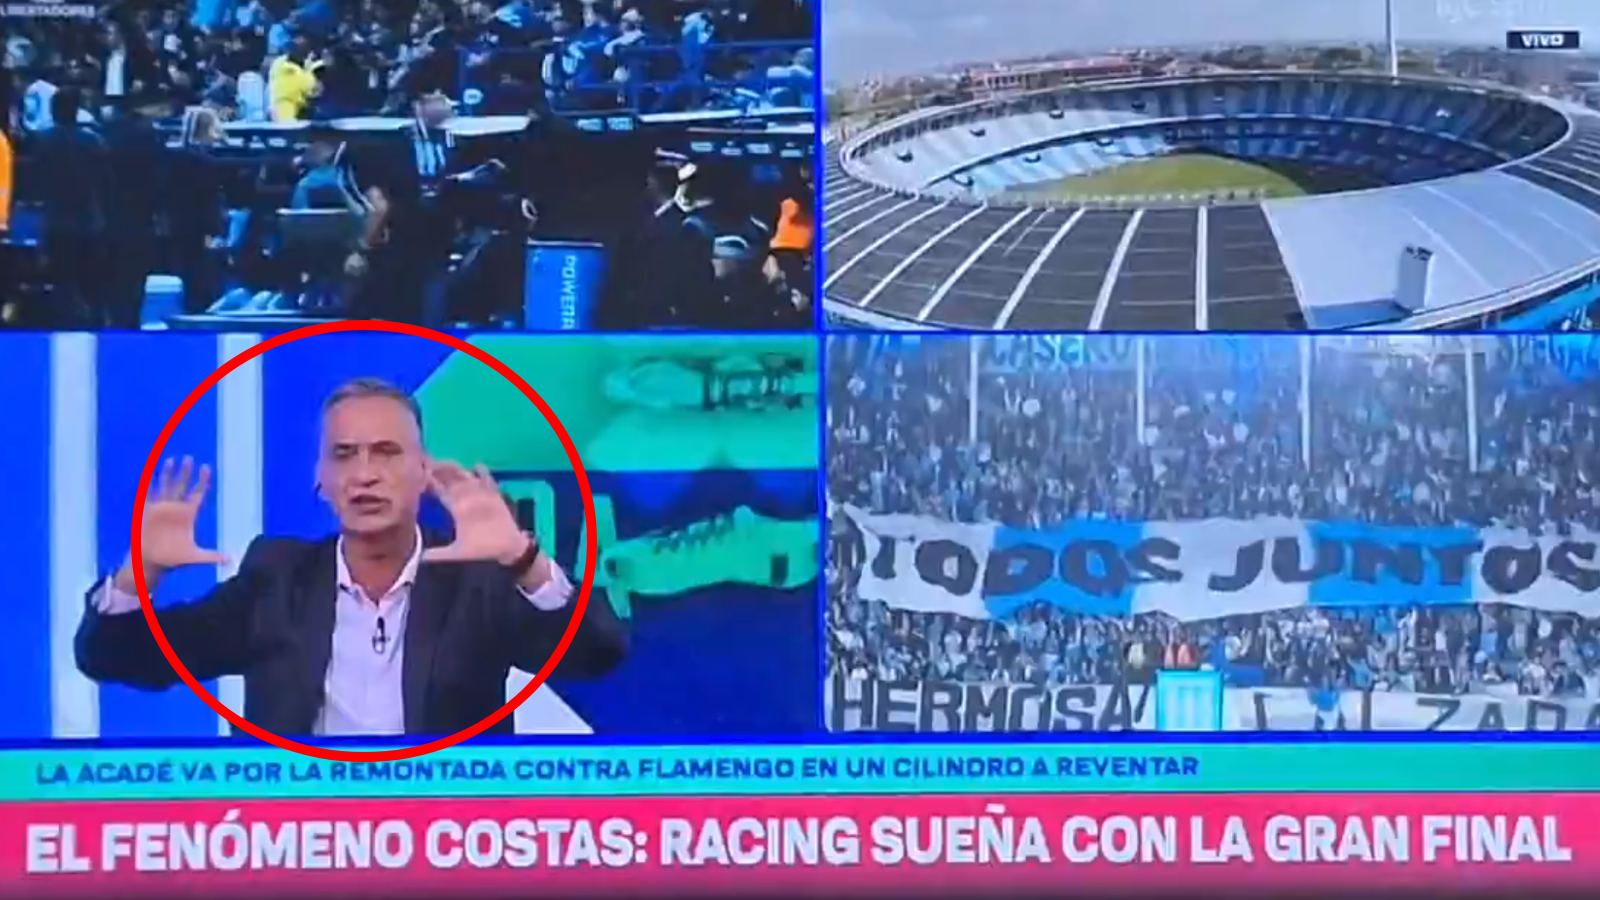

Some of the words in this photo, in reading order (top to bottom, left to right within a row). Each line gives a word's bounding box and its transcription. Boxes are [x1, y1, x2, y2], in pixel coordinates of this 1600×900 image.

[1521, 34, 1565, 47] VIVO
[872, 526, 1183, 597] TODOS
[1207, 535, 1600, 594] JUNTOS
[36, 764, 68, 784] LA
[183, 764, 216, 782] VA
[225, 763, 282, 782] POR
[290, 762, 322, 781] LA
[331, 760, 504, 782] REMONTADA
[515, 759, 630, 780] CONTRA
[639, 759, 794, 779] FLAMENGO
[802, 758, 838, 778] EN
[846, 759, 885, 777] UN
[893, 758, 1025, 777] CILINDRO
[1032, 758, 1048, 776] A
[1057, 757, 1199, 777] REVENTAR
[26, 824, 92, 873] EL
[102, 808, 414, 872] FENÓMENO
[425, 818, 648, 868] COSTAS:
[660, 816, 860, 866] RACING
[870, 802, 1052, 865] SUEÑA
[1061, 815, 1177, 864] CON
[1190, 816, 1254, 863] LA
[1263, 814, 1410, 862] GRAN
[1422, 815, 1573, 862] FINAL
